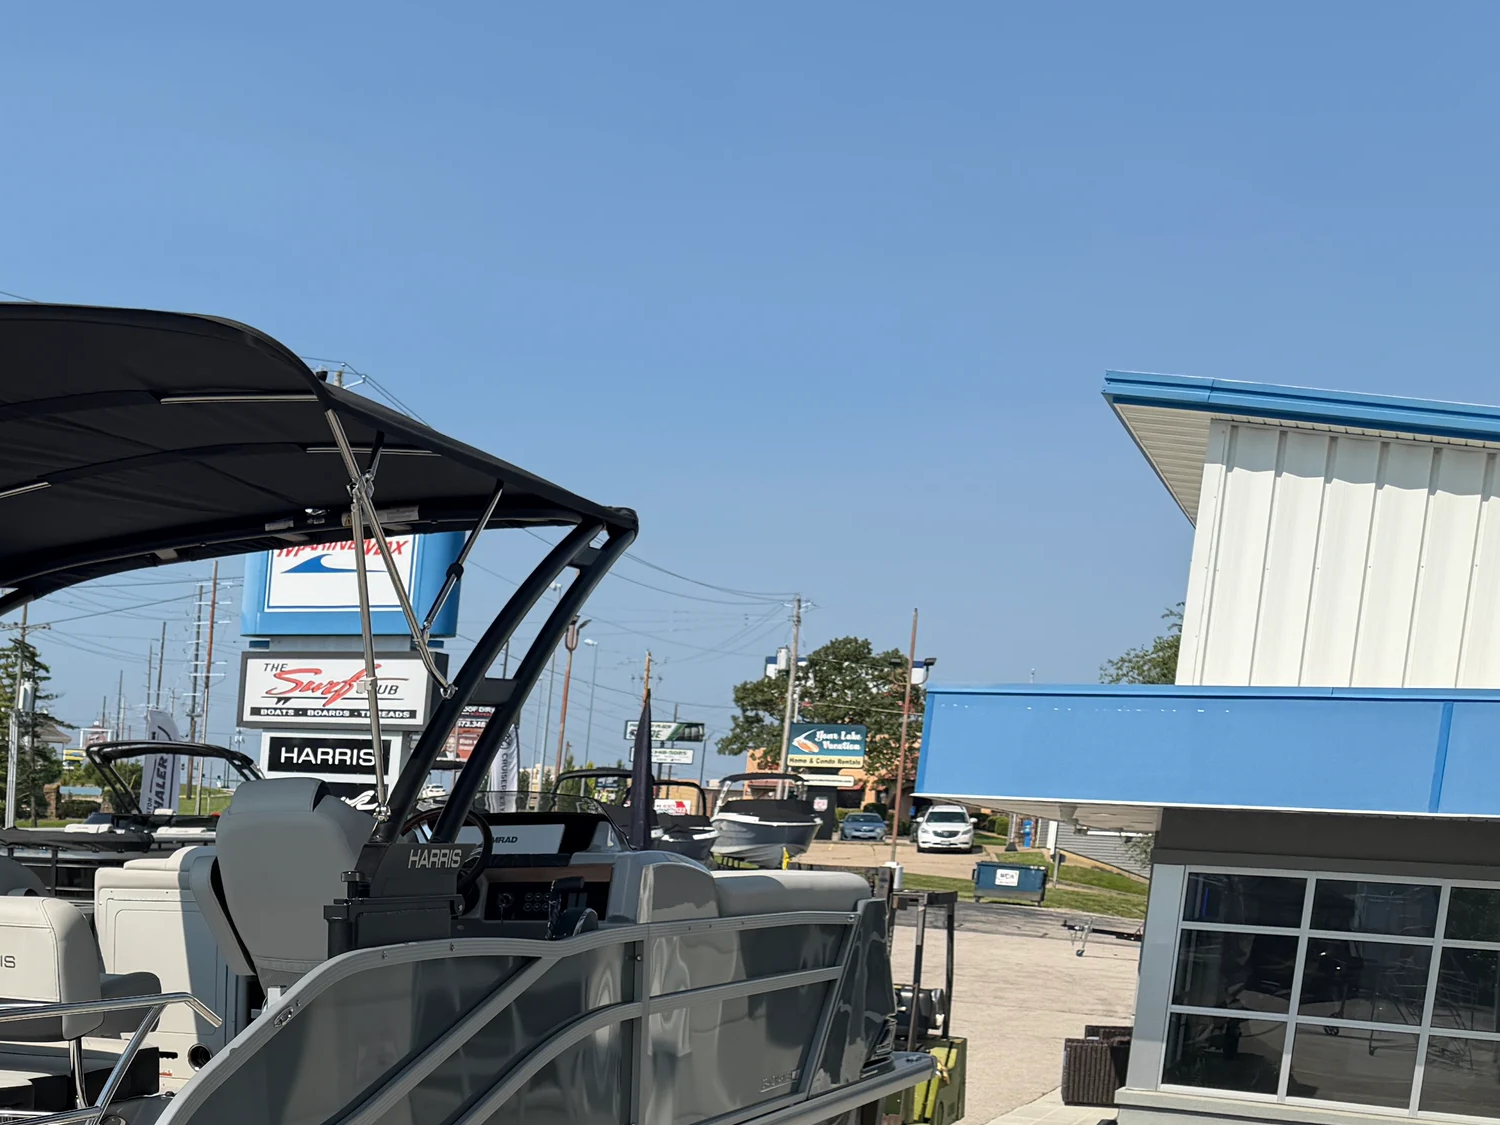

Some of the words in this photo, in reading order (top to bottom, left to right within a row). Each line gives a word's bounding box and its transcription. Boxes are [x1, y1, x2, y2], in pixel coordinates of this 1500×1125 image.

[264, 663, 288, 672] THE
[265, 664, 381, 707] Surf
[815, 730, 838, 742] Your
[841, 731, 862, 740] Lake
[822, 741, 861, 750] Vacation
[280, 746, 376, 766] HARRIS
[153, 756, 168, 810] HALER
[493, 836, 518, 844] MRAD
[408, 849, 462, 868] HARRIS
